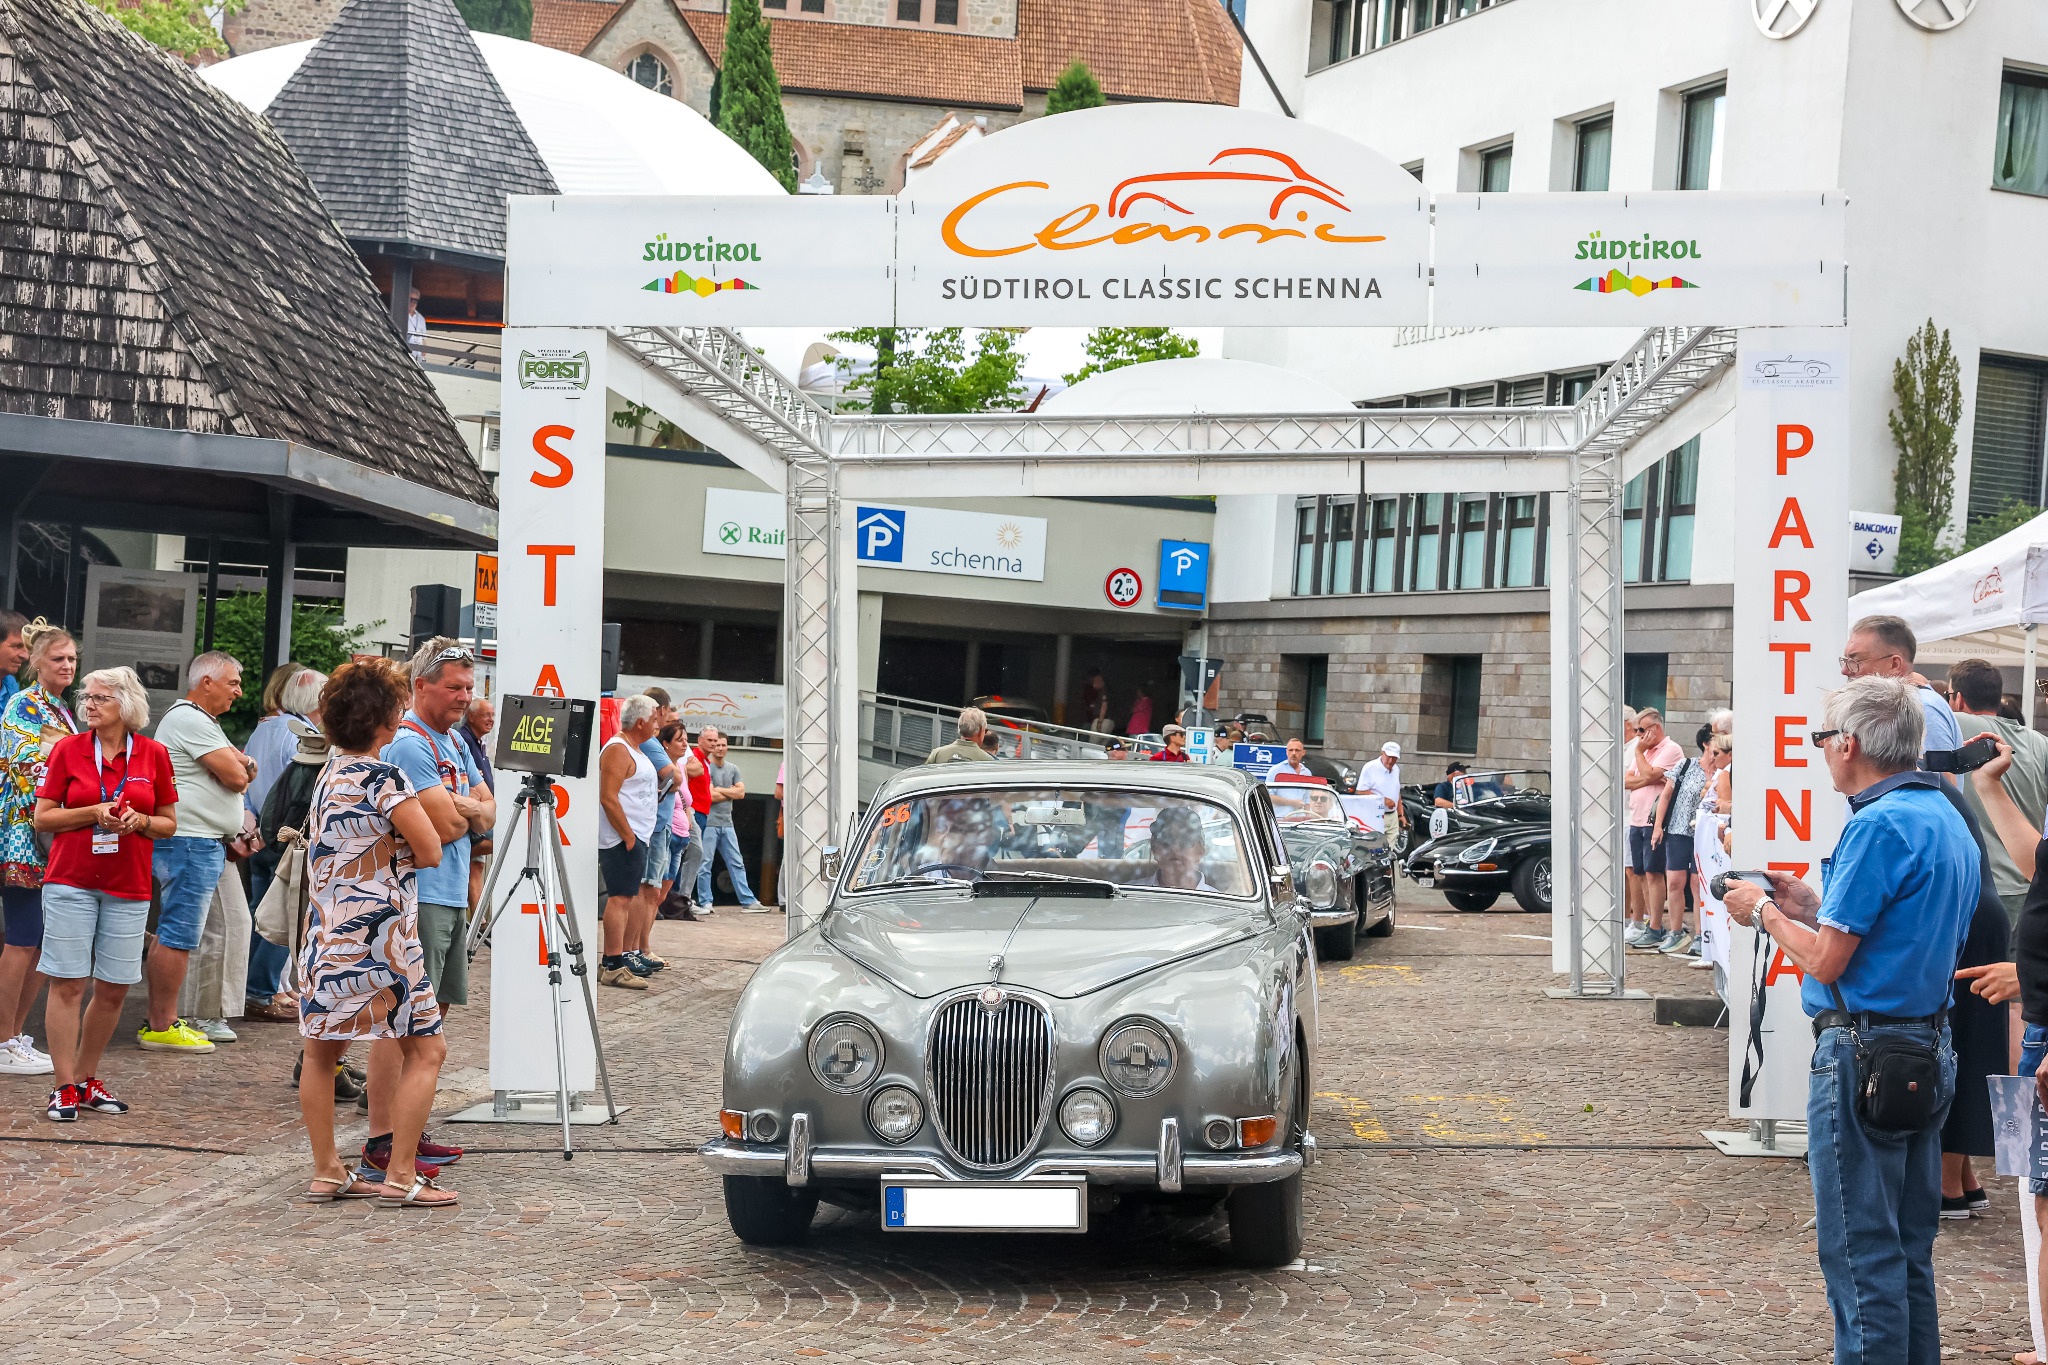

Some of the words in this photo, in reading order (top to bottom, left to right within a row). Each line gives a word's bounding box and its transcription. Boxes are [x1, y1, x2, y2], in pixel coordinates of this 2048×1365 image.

[941, 274, 1090, 300] SÜDTIROL
[1102, 277, 1222, 300] CLASSIC
[1234, 276, 1383, 300] SCHENNA
[525, 361, 583, 379] FORST
[1853, 521, 1898, 535] BANCOMAT
[867, 526, 893, 556] P
[931, 546, 1023, 573] schenna
[1176, 556, 1191, 576] P
[478, 567, 497, 592] TAX
[512, 714, 555, 743] ALGE
[513, 742, 549, 753] TIMING
[882, 803, 911, 828] 56
[1434, 819, 1443, 833] 59
[891, 1210, 899, 1220] D
